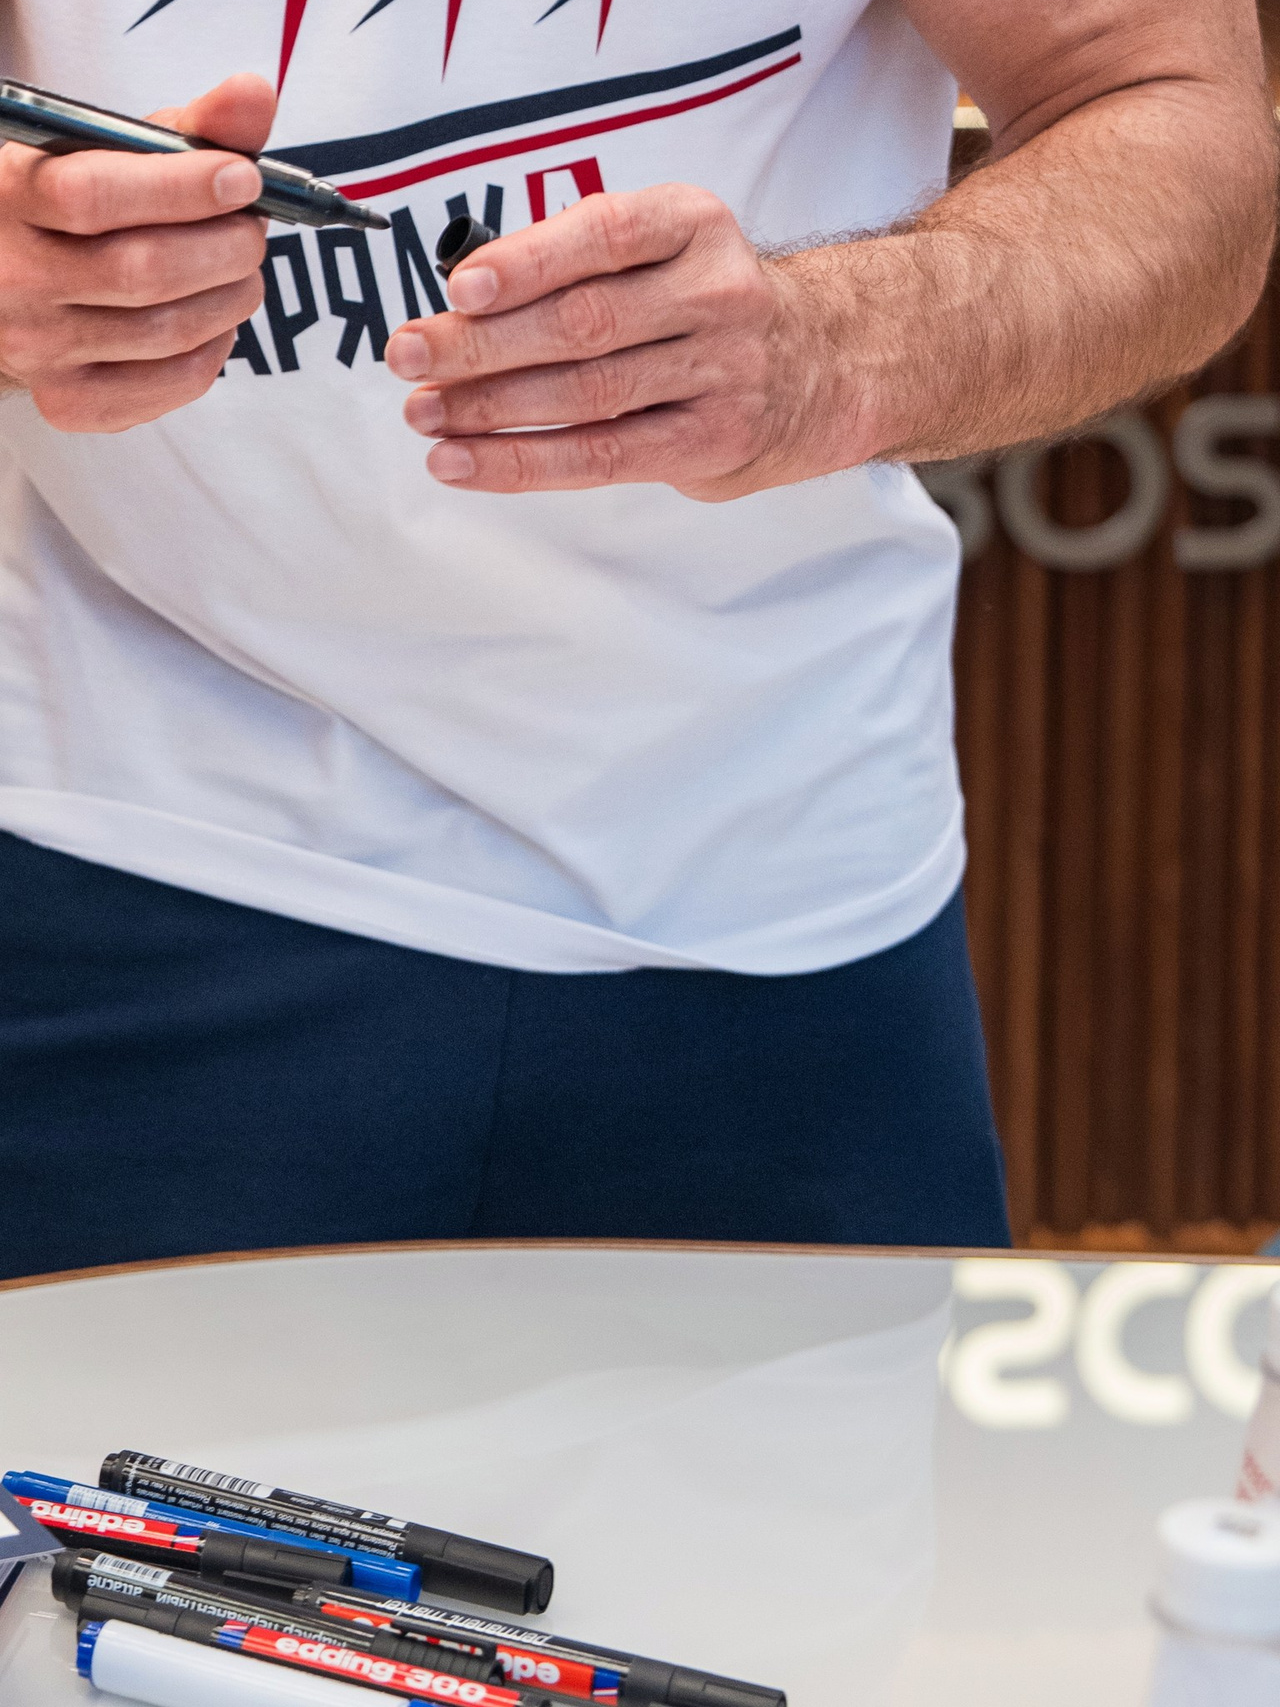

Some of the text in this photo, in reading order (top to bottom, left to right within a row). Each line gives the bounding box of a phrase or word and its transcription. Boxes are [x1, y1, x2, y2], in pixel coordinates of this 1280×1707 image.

[28, 1499, 146, 1536] edding
[376, 1596, 444, 1625] marker
[447, 1610, 551, 1649] permanent
[275, 1637, 488, 1702] edding 300
